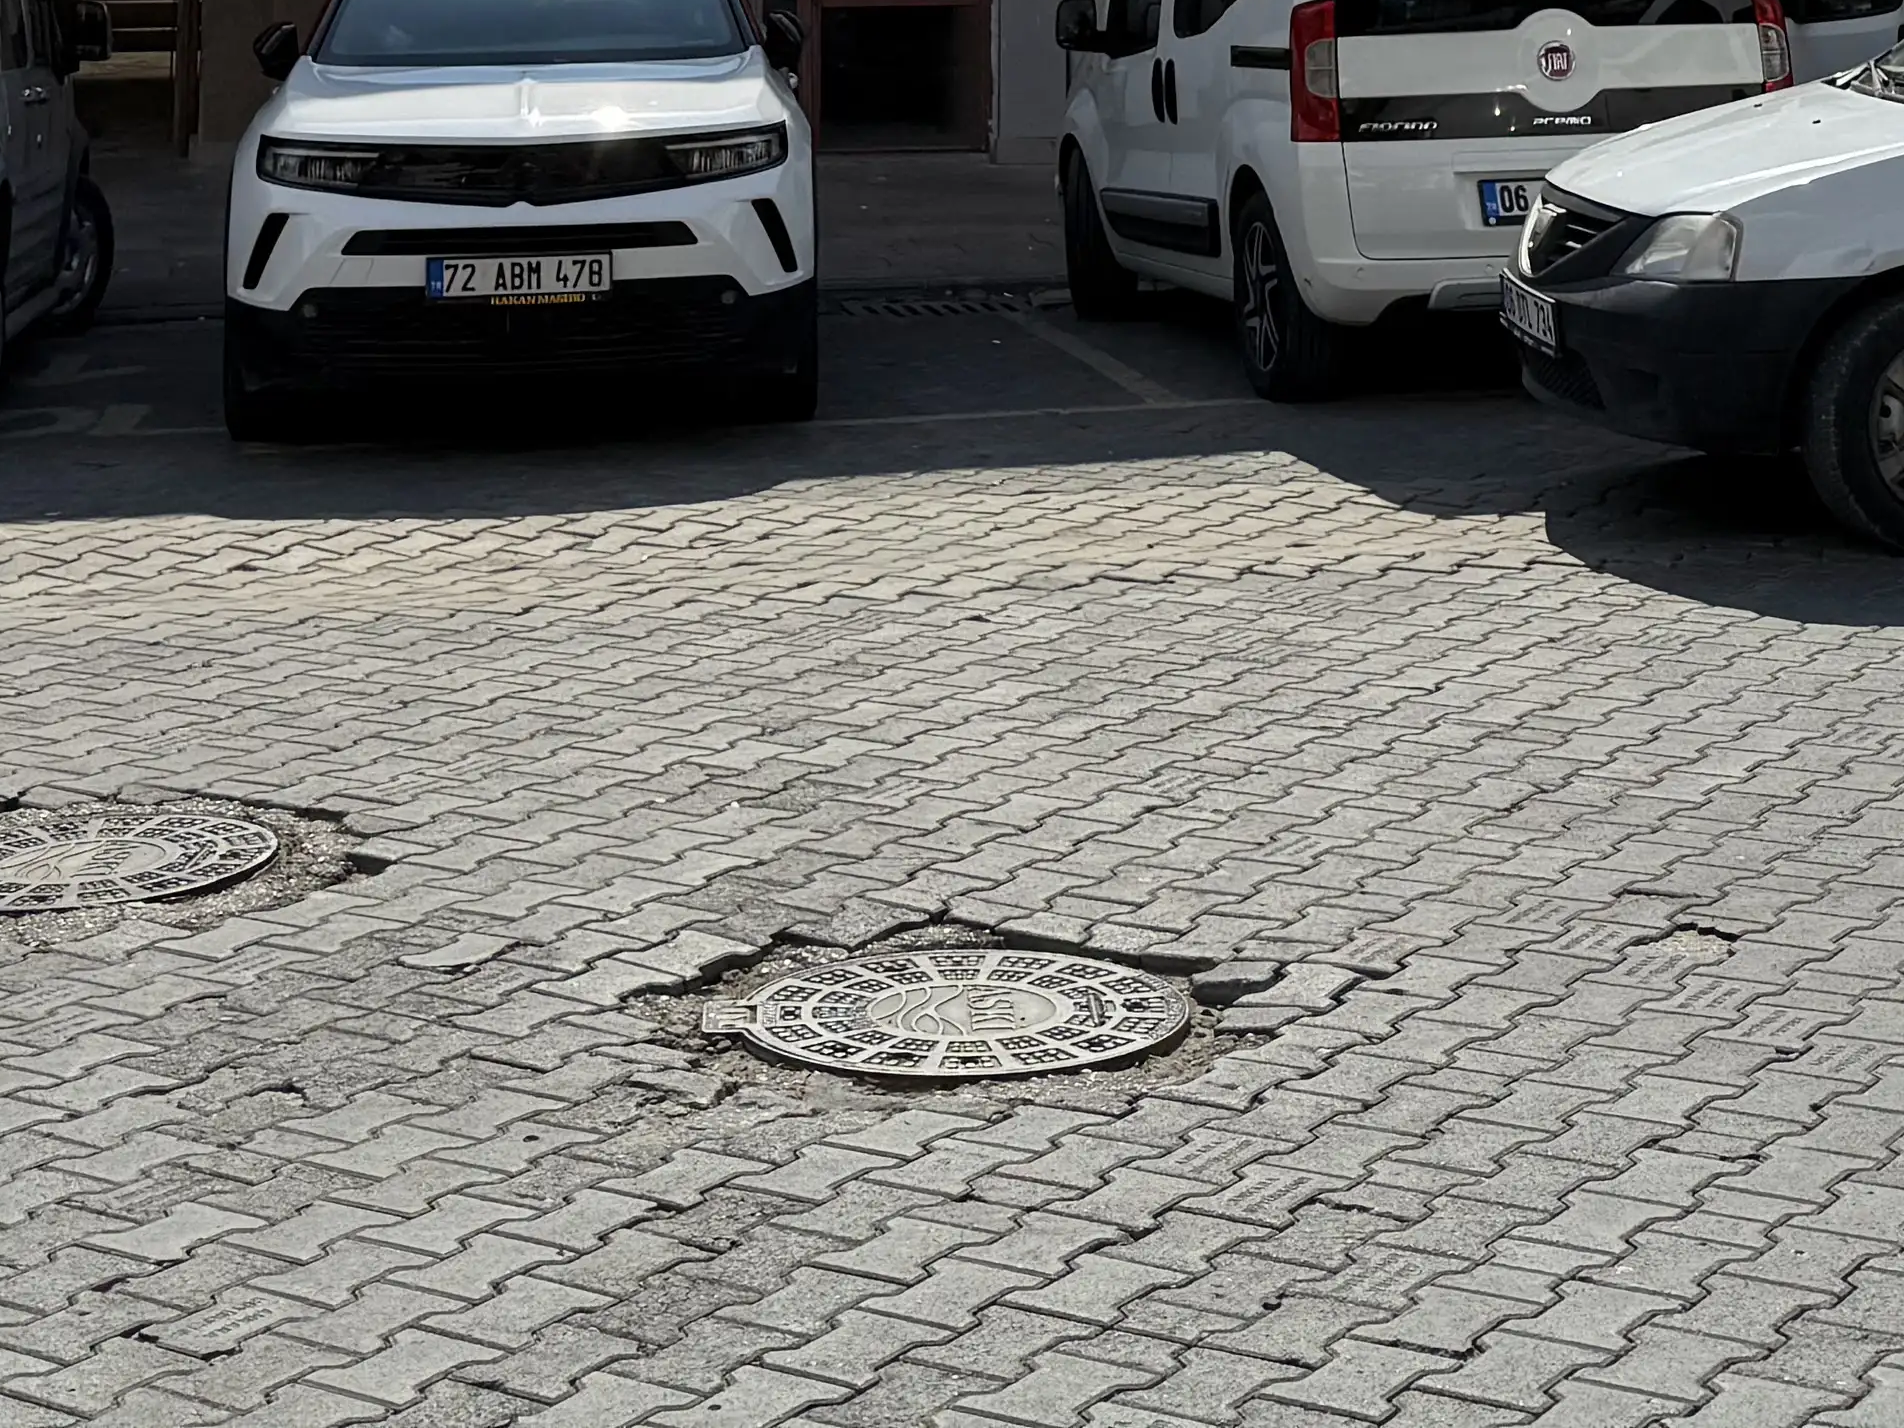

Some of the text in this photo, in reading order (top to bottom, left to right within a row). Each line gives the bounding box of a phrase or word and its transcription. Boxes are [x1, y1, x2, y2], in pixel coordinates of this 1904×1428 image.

[1499, 184, 1530, 214] 06
[444, 258, 604, 292] 72 ABM 478
